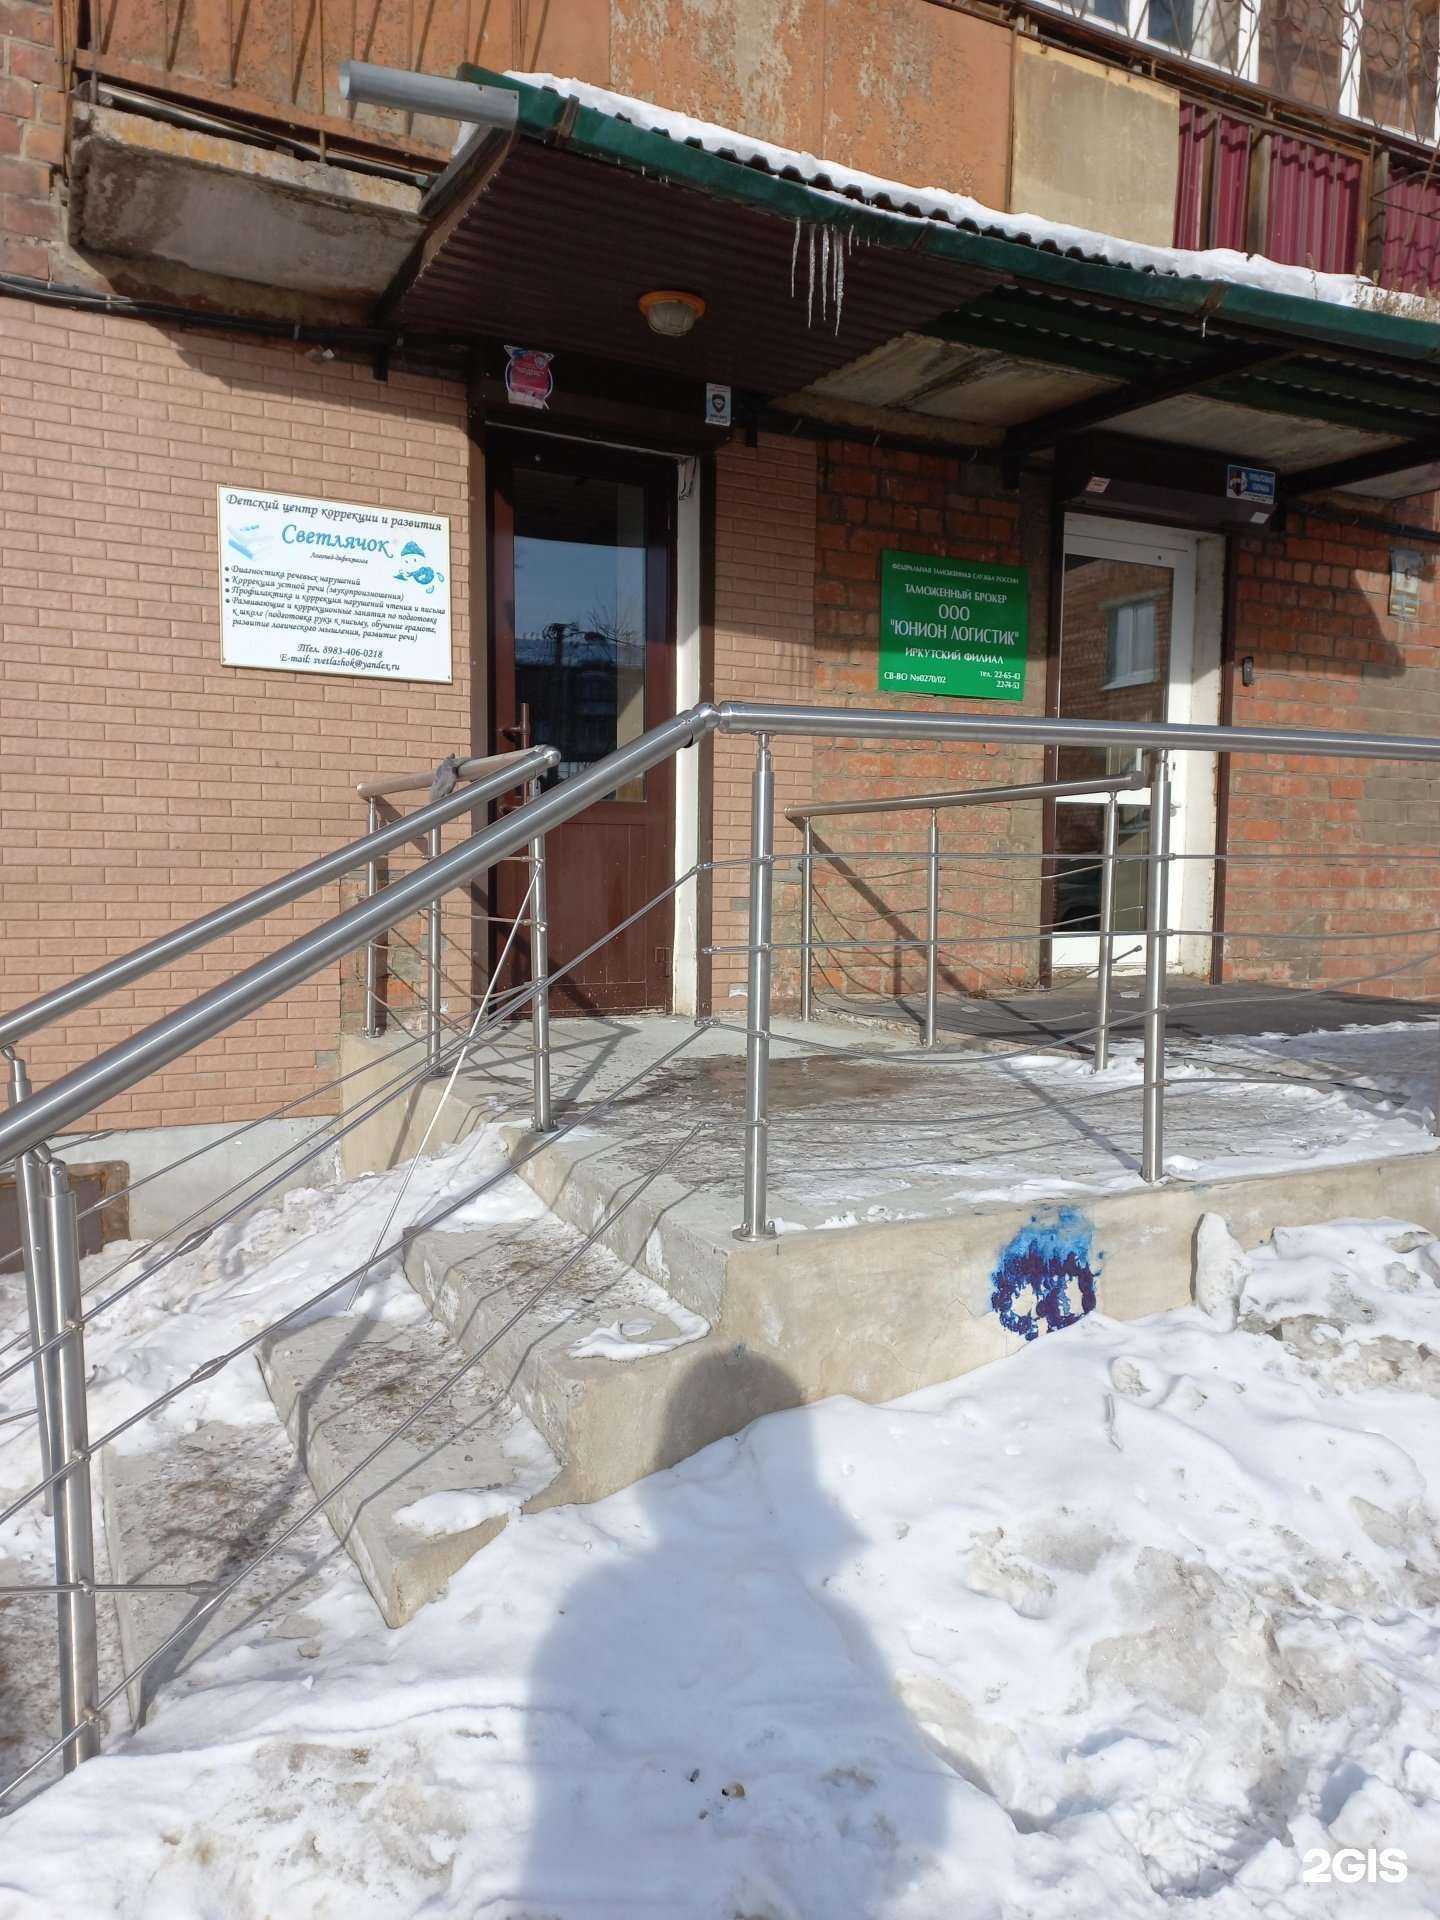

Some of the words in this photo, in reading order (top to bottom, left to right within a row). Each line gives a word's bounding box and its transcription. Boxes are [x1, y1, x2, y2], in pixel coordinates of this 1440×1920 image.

[226, 494, 279, 511] Детский
[282, 503, 318, 518] центр
[321, 509, 378, 524] коррекции
[382, 516, 388, 524] и
[391, 517, 442, 531] развития
[282, 524, 394, 558] Светлячок
[231, 565, 285, 579] Диагностика
[286, 572, 318, 583] речевых
[320, 575, 360, 586] нарушений
[232, 575, 275, 588] Коррекция
[277, 581, 305, 590] устной
[307, 585, 325, 593] речи
[232, 586, 293, 600] Профилактика
[302, 594, 342, 605] коррекция
[343, 598, 384, 608] нарушений
[385, 603, 412, 611] чтения
[420, 606, 446, 615] письма
[904, 583, 972, 600] ТАМОЖЕННЫЙ
[974, 591, 1008, 603] БРОКЕР
[232, 596, 285, 609] Развивающие
[294, 604, 352, 615] коррекционные
[353, 609, 386, 619] занятия
[938, 603, 970, 621] ООО
[232, 619, 270, 628] развитие
[271, 623, 317, 632] логического
[362, 630, 398, 639] развитие
[239, 609, 263, 617] школе
[265, 610, 312, 623] (подготовка
[314, 616, 332, 625] руки
[371, 619, 404, 630] обучение
[890, 618, 947, 639] "ЮНИОН
[950, 626, 1020, 645] ЛОГИСТИК"
[280, 653, 311, 664] E-mail:
[297, 644, 320, 654] Тел.
[322, 645, 383, 658] 8983-406-0218
[905, 648, 961, 661] ИРКУТСКИЙ
[963, 652, 1004, 664] ФИЛИАЛ
[884, 671, 908, 681] СВ-ВО
